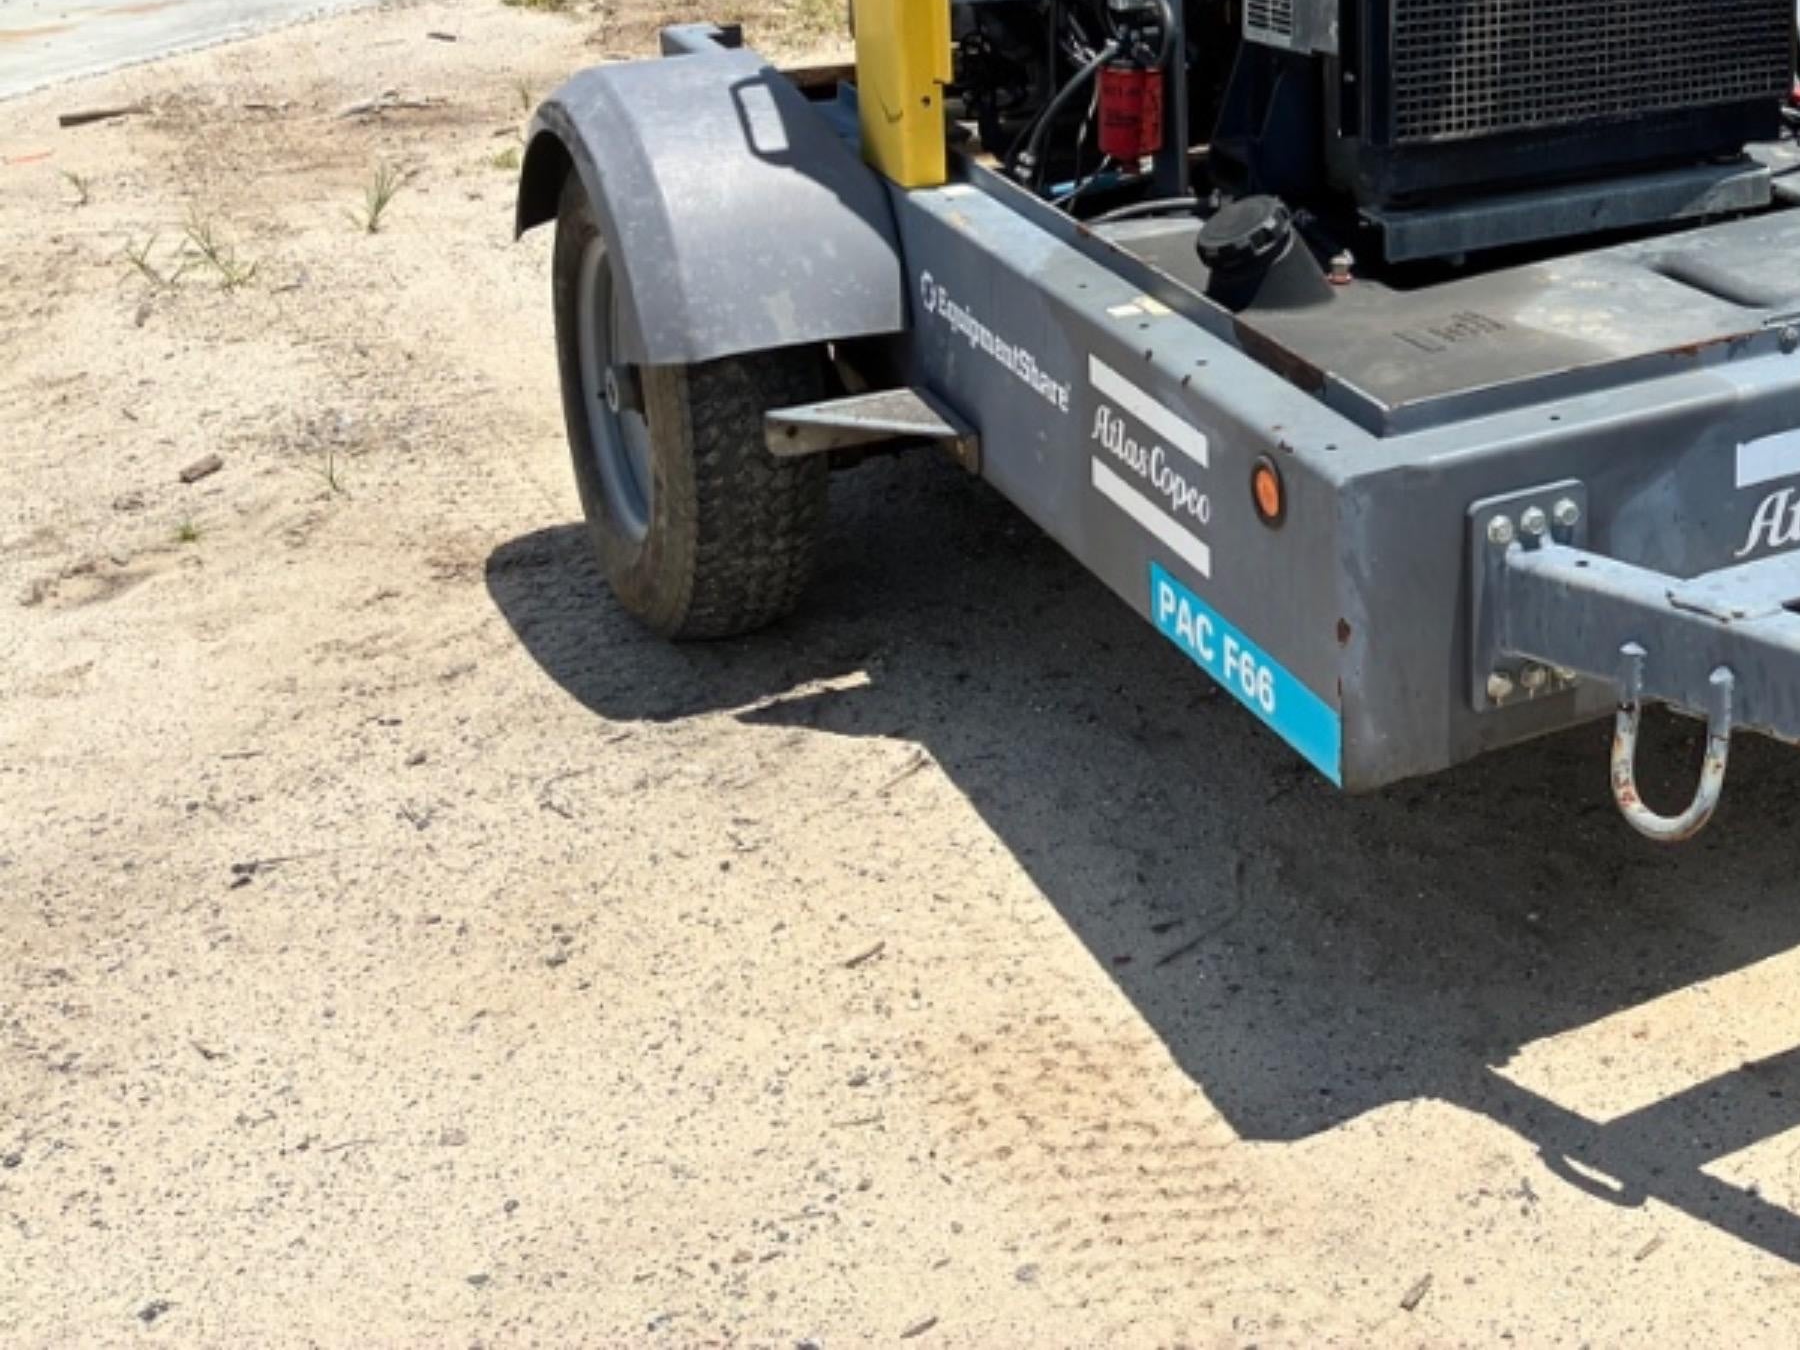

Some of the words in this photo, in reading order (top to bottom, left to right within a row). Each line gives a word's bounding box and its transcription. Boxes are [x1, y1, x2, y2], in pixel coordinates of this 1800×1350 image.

[938, 287, 1069, 412] EquipmentShare
[1159, 580, 1214, 662] PAC
[1223, 633, 1276, 714] F66
